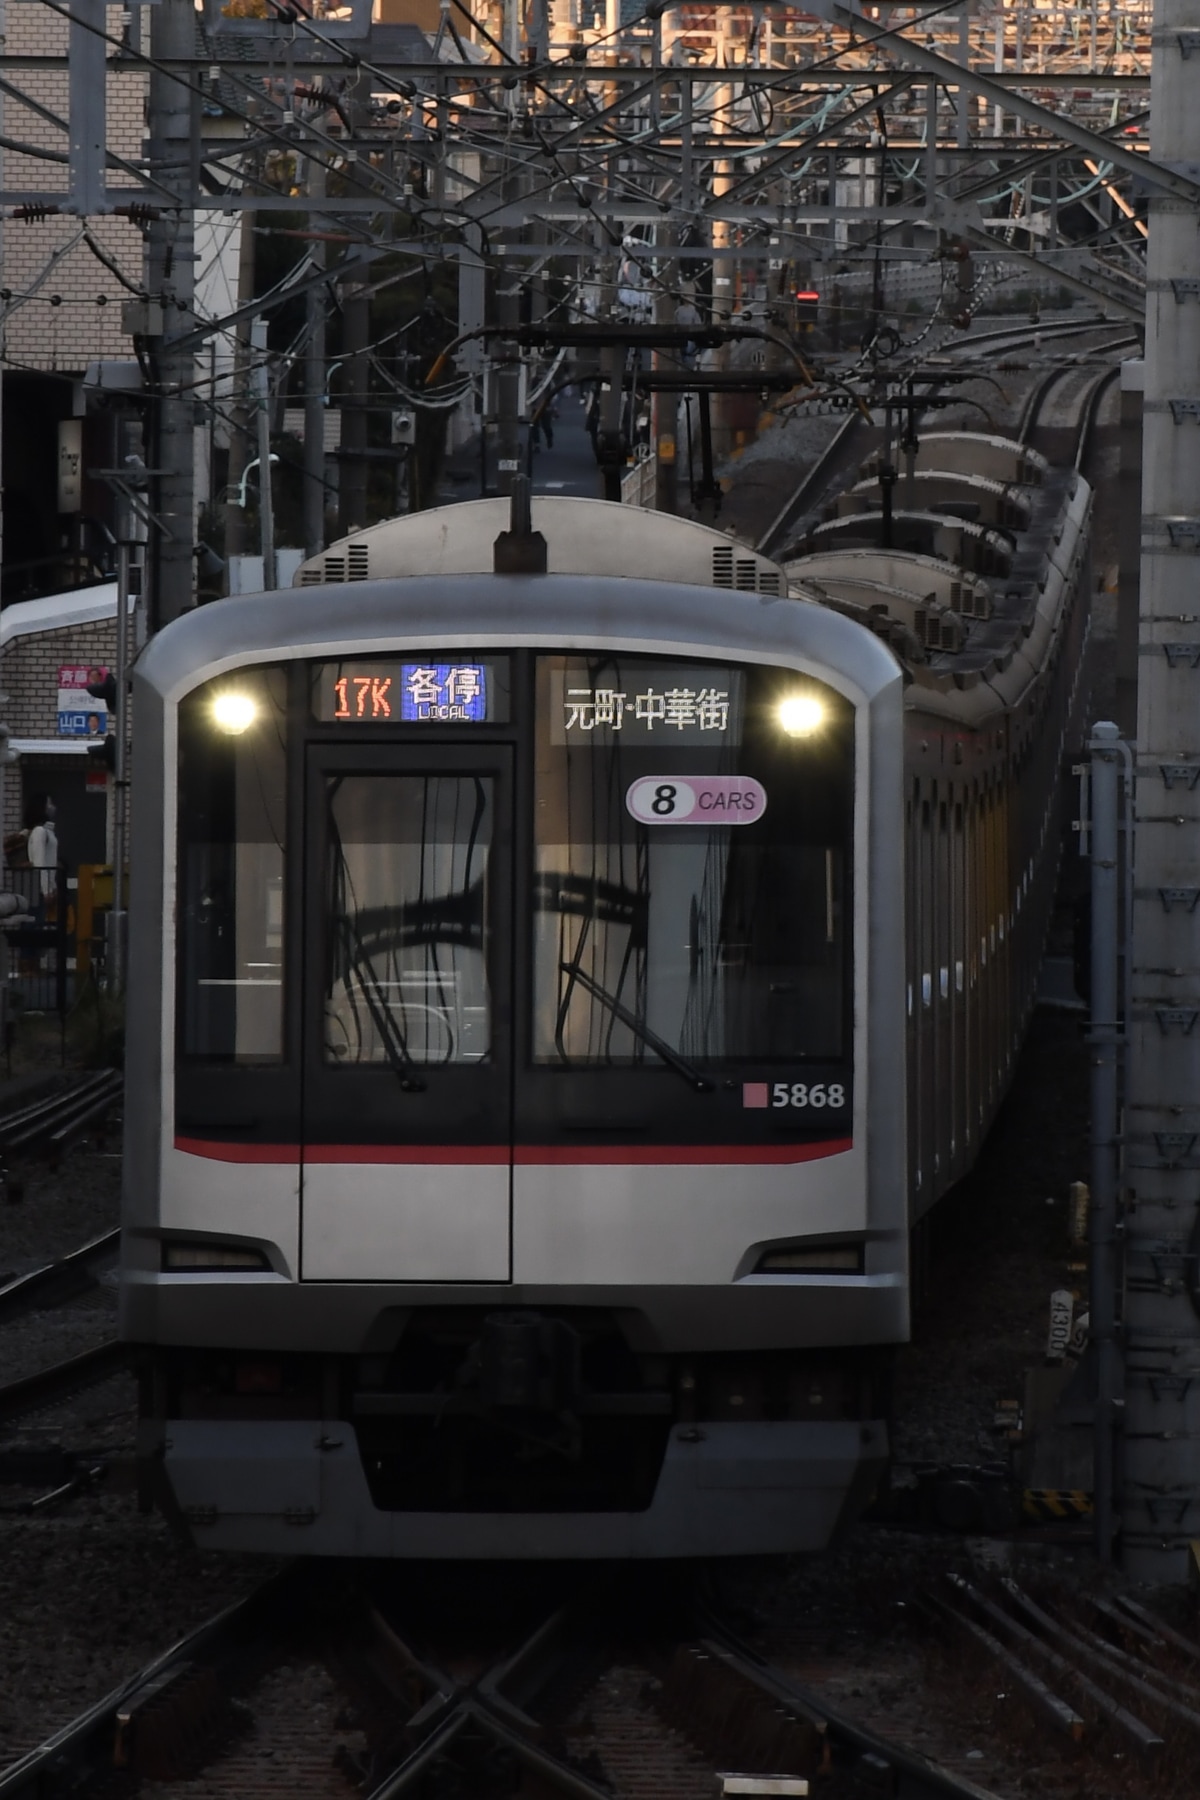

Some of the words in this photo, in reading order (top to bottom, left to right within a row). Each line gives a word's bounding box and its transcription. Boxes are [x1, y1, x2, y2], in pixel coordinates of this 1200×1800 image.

[334, 677, 392, 718] 17K
[405, 667, 482, 705] 各停
[60, 715, 86, 728] 山口
[418, 704, 470, 720] LOCAL
[651, 784, 677, 815] 8
[698, 791, 757, 811] CARS
[772, 1083, 845, 1108] 5868
